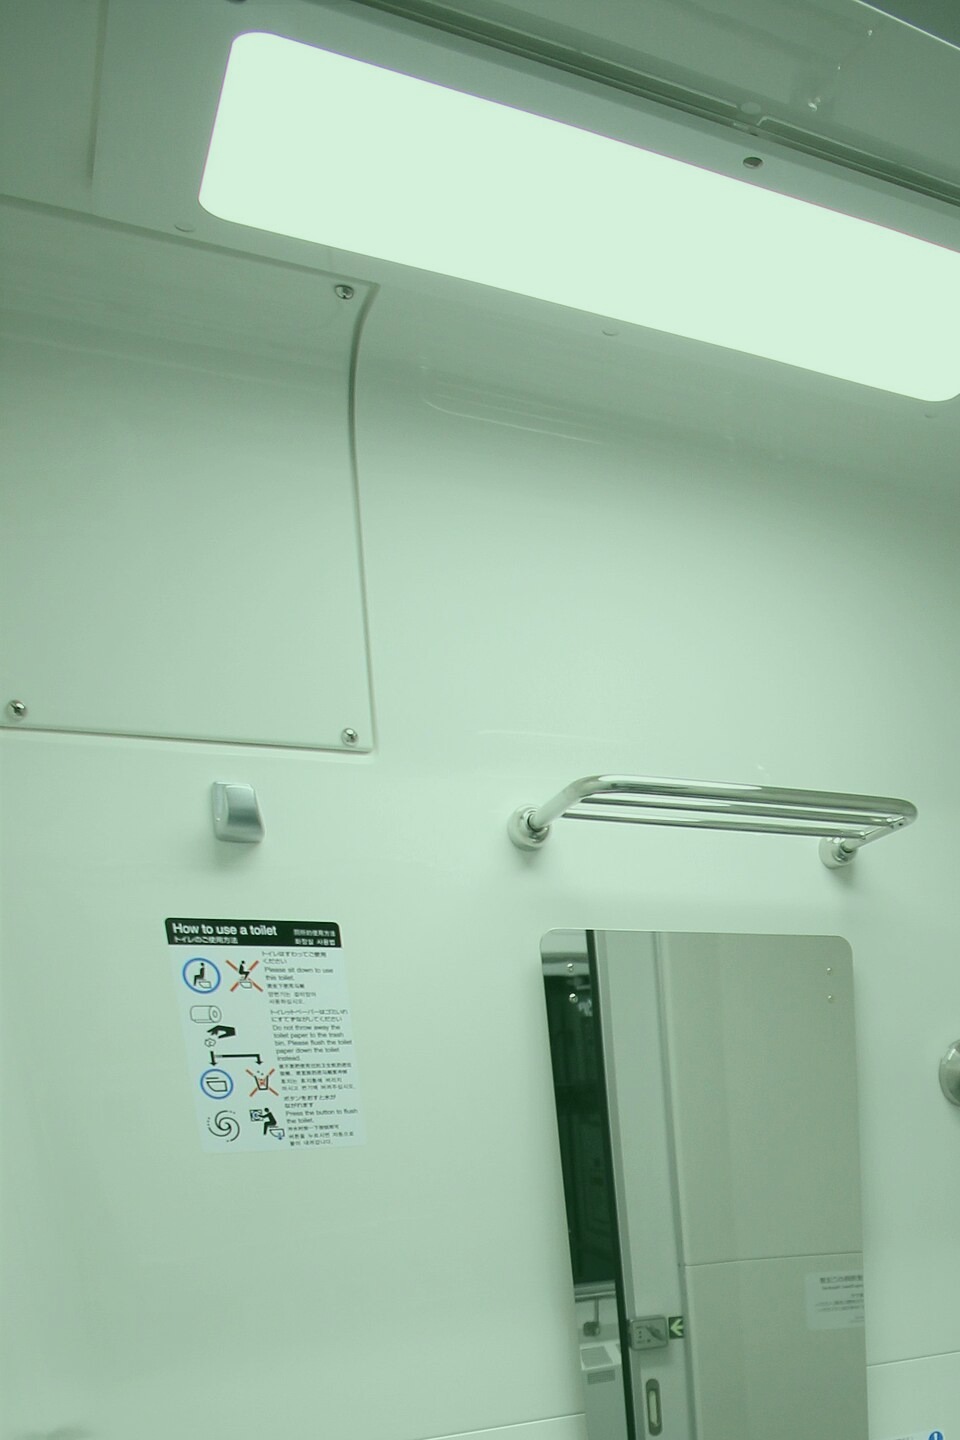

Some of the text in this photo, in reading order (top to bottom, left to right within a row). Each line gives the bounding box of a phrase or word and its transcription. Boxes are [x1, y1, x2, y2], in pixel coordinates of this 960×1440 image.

[172, 923, 277, 936] How to use a toilet
